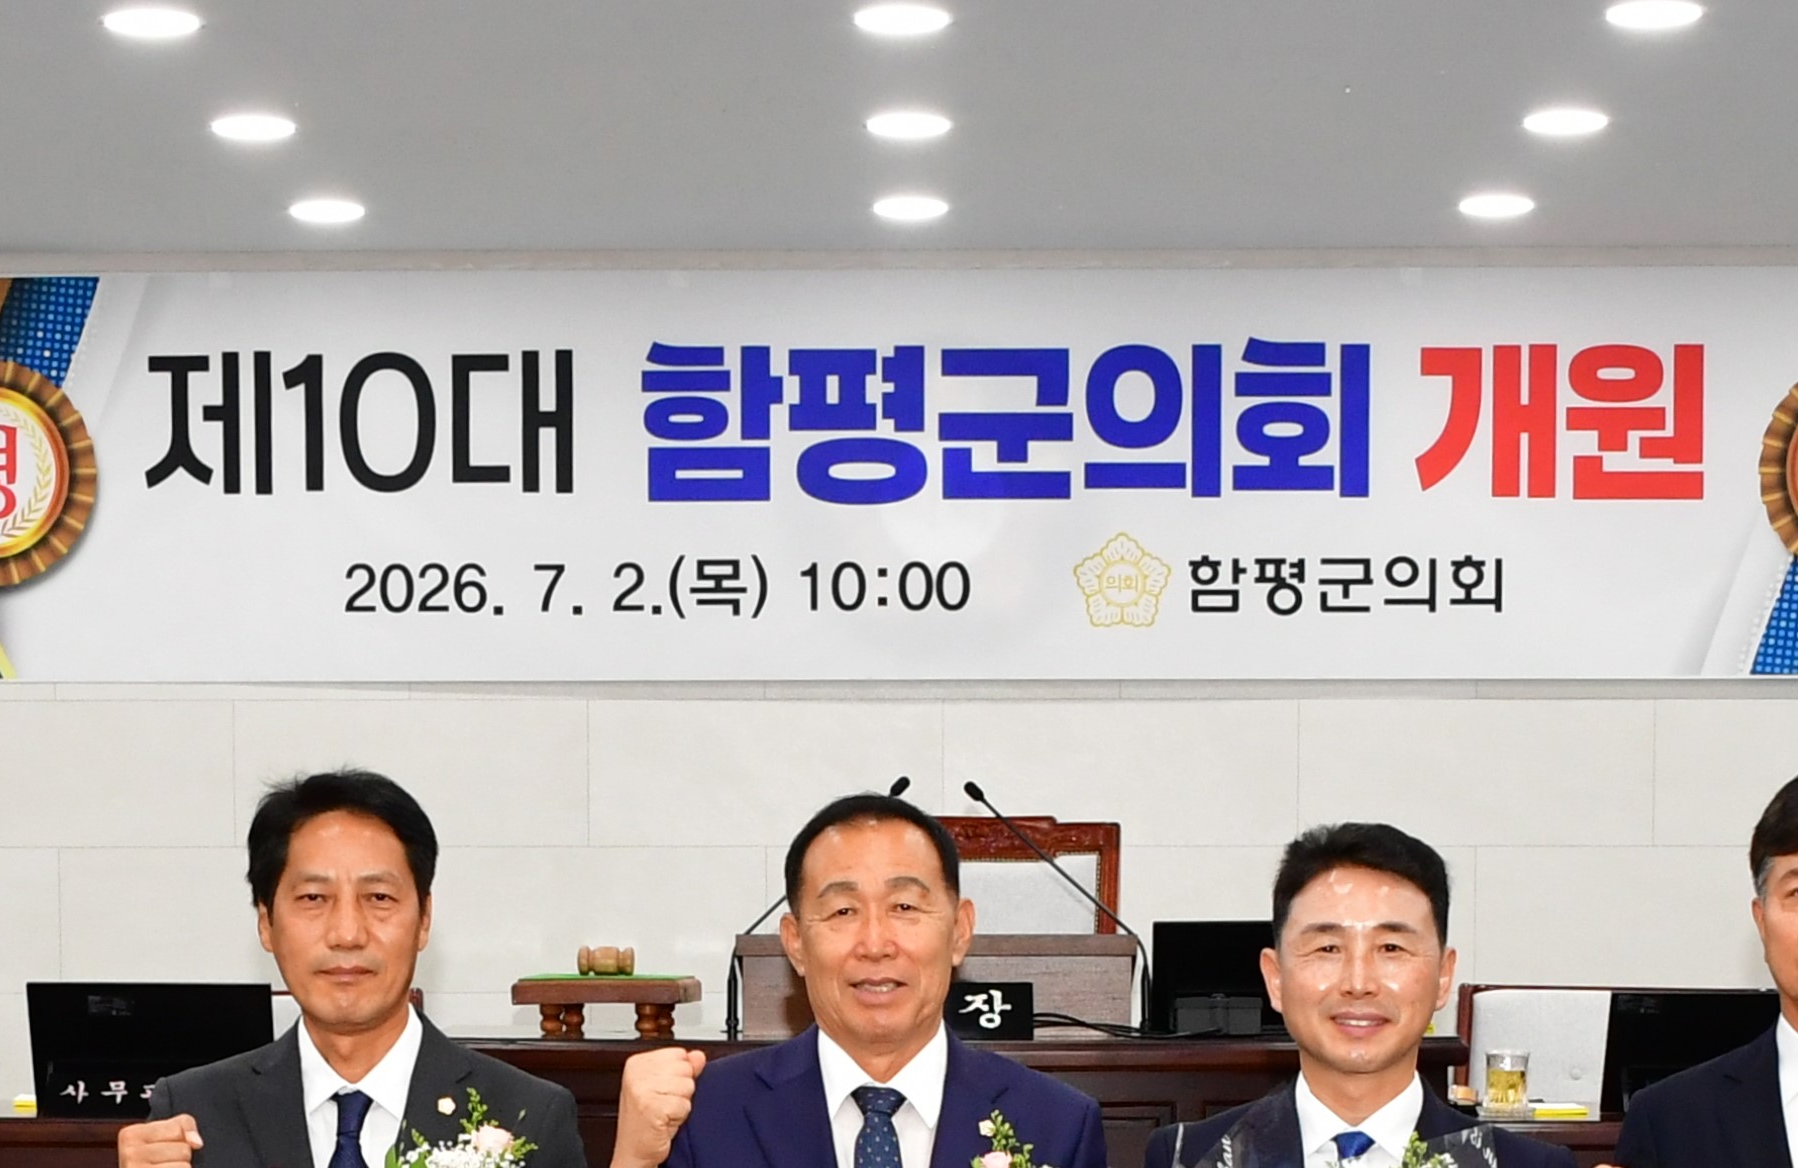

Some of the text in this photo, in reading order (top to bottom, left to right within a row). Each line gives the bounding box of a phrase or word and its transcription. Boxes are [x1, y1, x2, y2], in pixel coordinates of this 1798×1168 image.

[145, 337, 1706, 507] 제10대 함평군의회 개원
[346, 562, 505, 615] 2026.
[534, 562, 584, 615] 7.
[801, 560, 972, 613] 10:00
[1189, 556, 1504, 617] 함평군의회
[958, 989, 1012, 1029] 장
